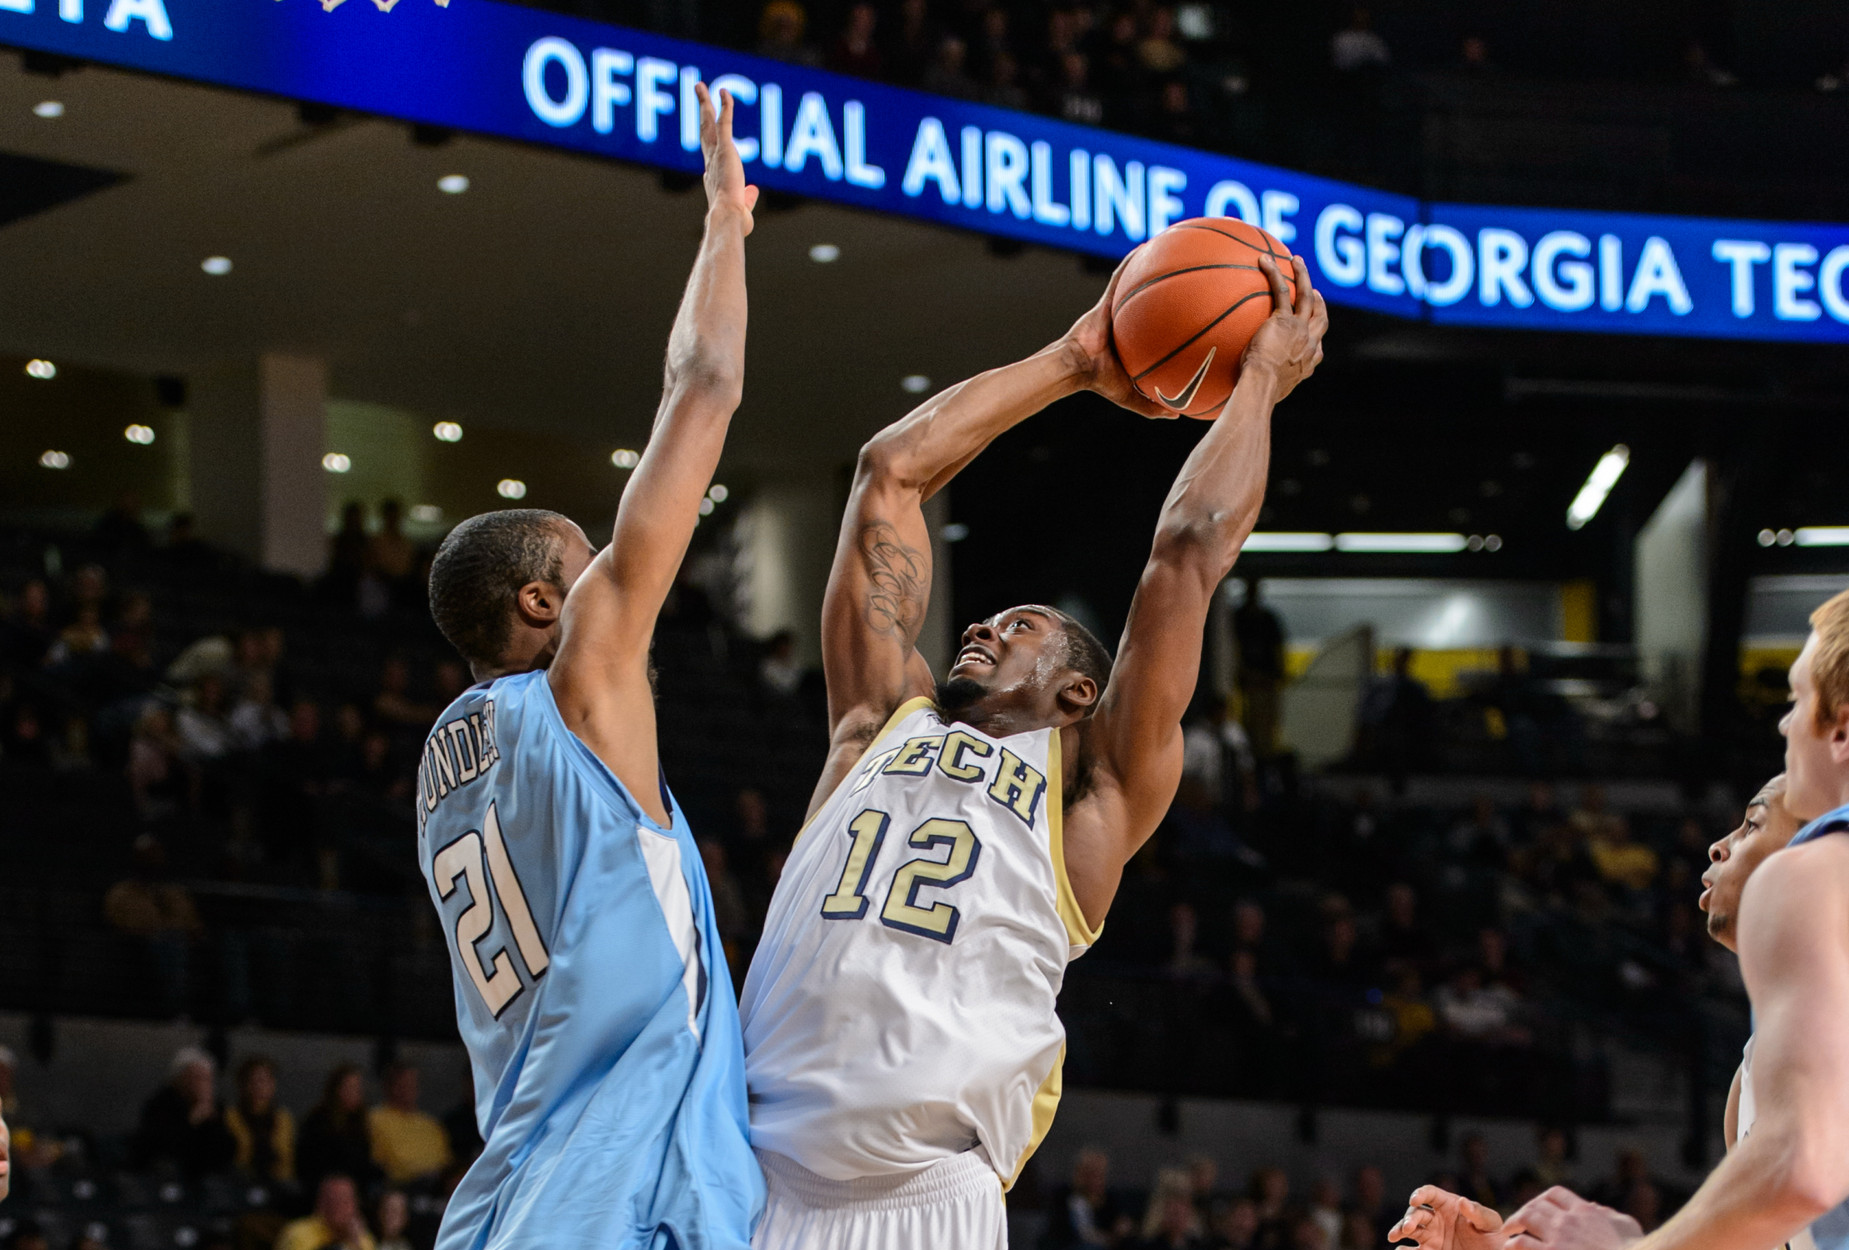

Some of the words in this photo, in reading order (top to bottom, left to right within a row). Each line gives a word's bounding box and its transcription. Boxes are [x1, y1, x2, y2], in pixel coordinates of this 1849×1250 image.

[522, 37, 885, 190] OFFICIAL
[902, 117, 1187, 242] AIRLINE
[1313, 203, 1693, 315] GEORGIA
[850, 730, 1047, 831] TECH
[433, 798, 550, 1022] 21
[820, 808, 982, 946] 12
